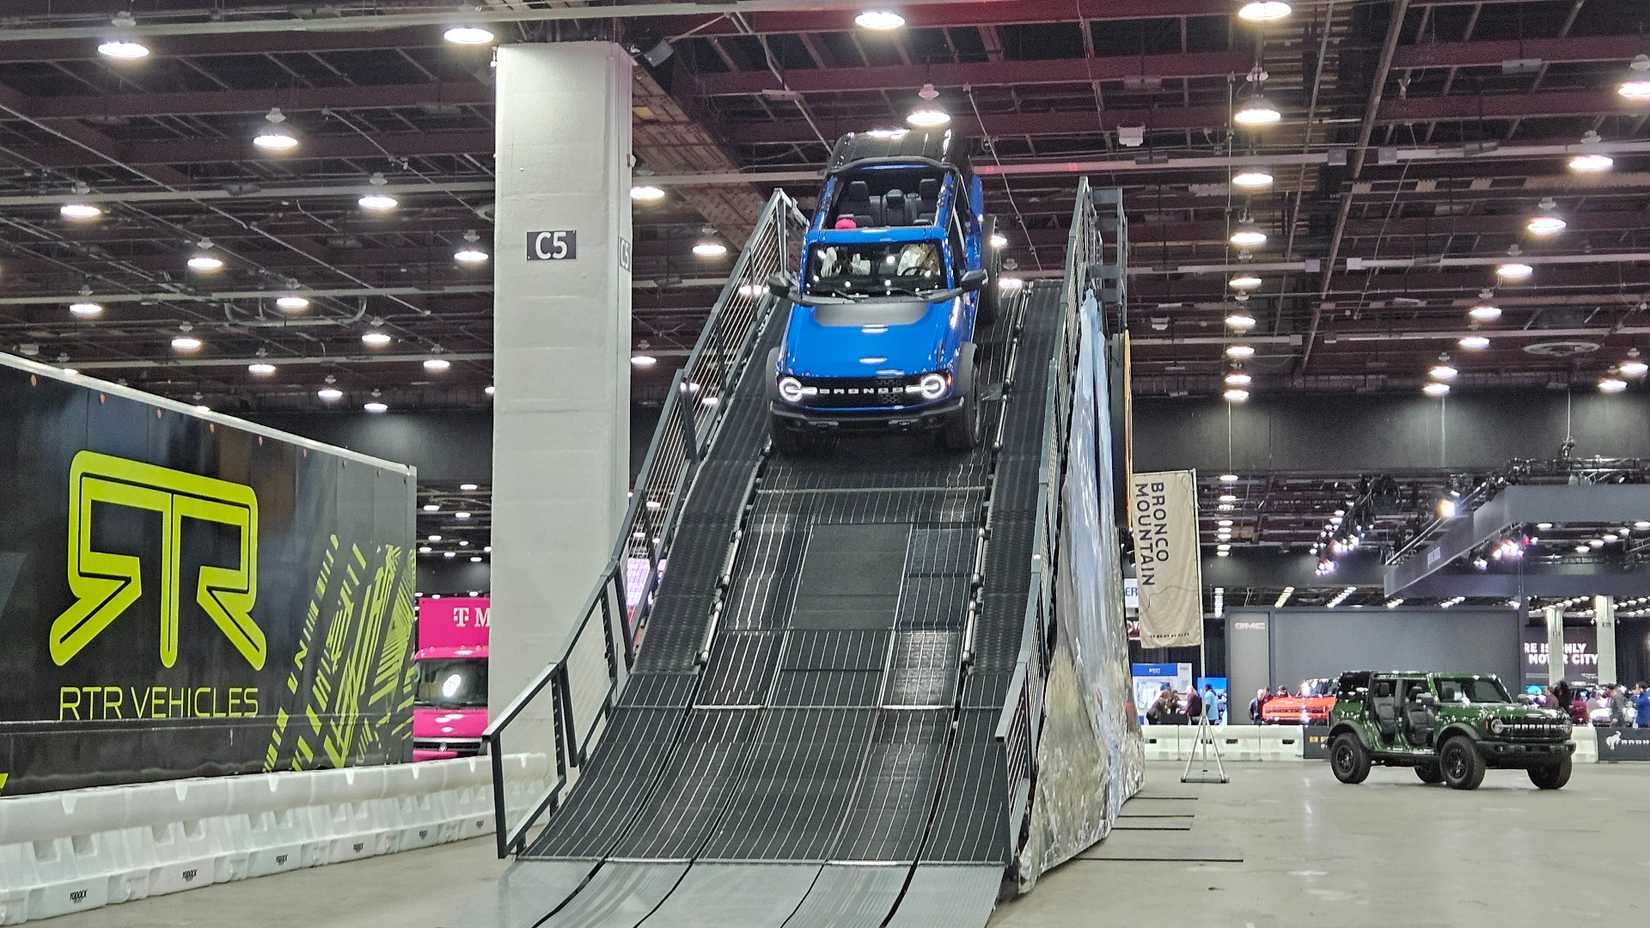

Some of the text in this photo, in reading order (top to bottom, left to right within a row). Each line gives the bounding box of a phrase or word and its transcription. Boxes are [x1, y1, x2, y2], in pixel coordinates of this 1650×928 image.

[535, 231, 568, 259] C5
[819, 387, 904, 395] BRONCO
[1135, 482, 1155, 586] MOUNTAIN
[1151, 482, 1169, 562] BRONCO
[1528, 653, 1599, 665] MOTR CITY
[59, 686, 259, 720] RTR VEHICLES
